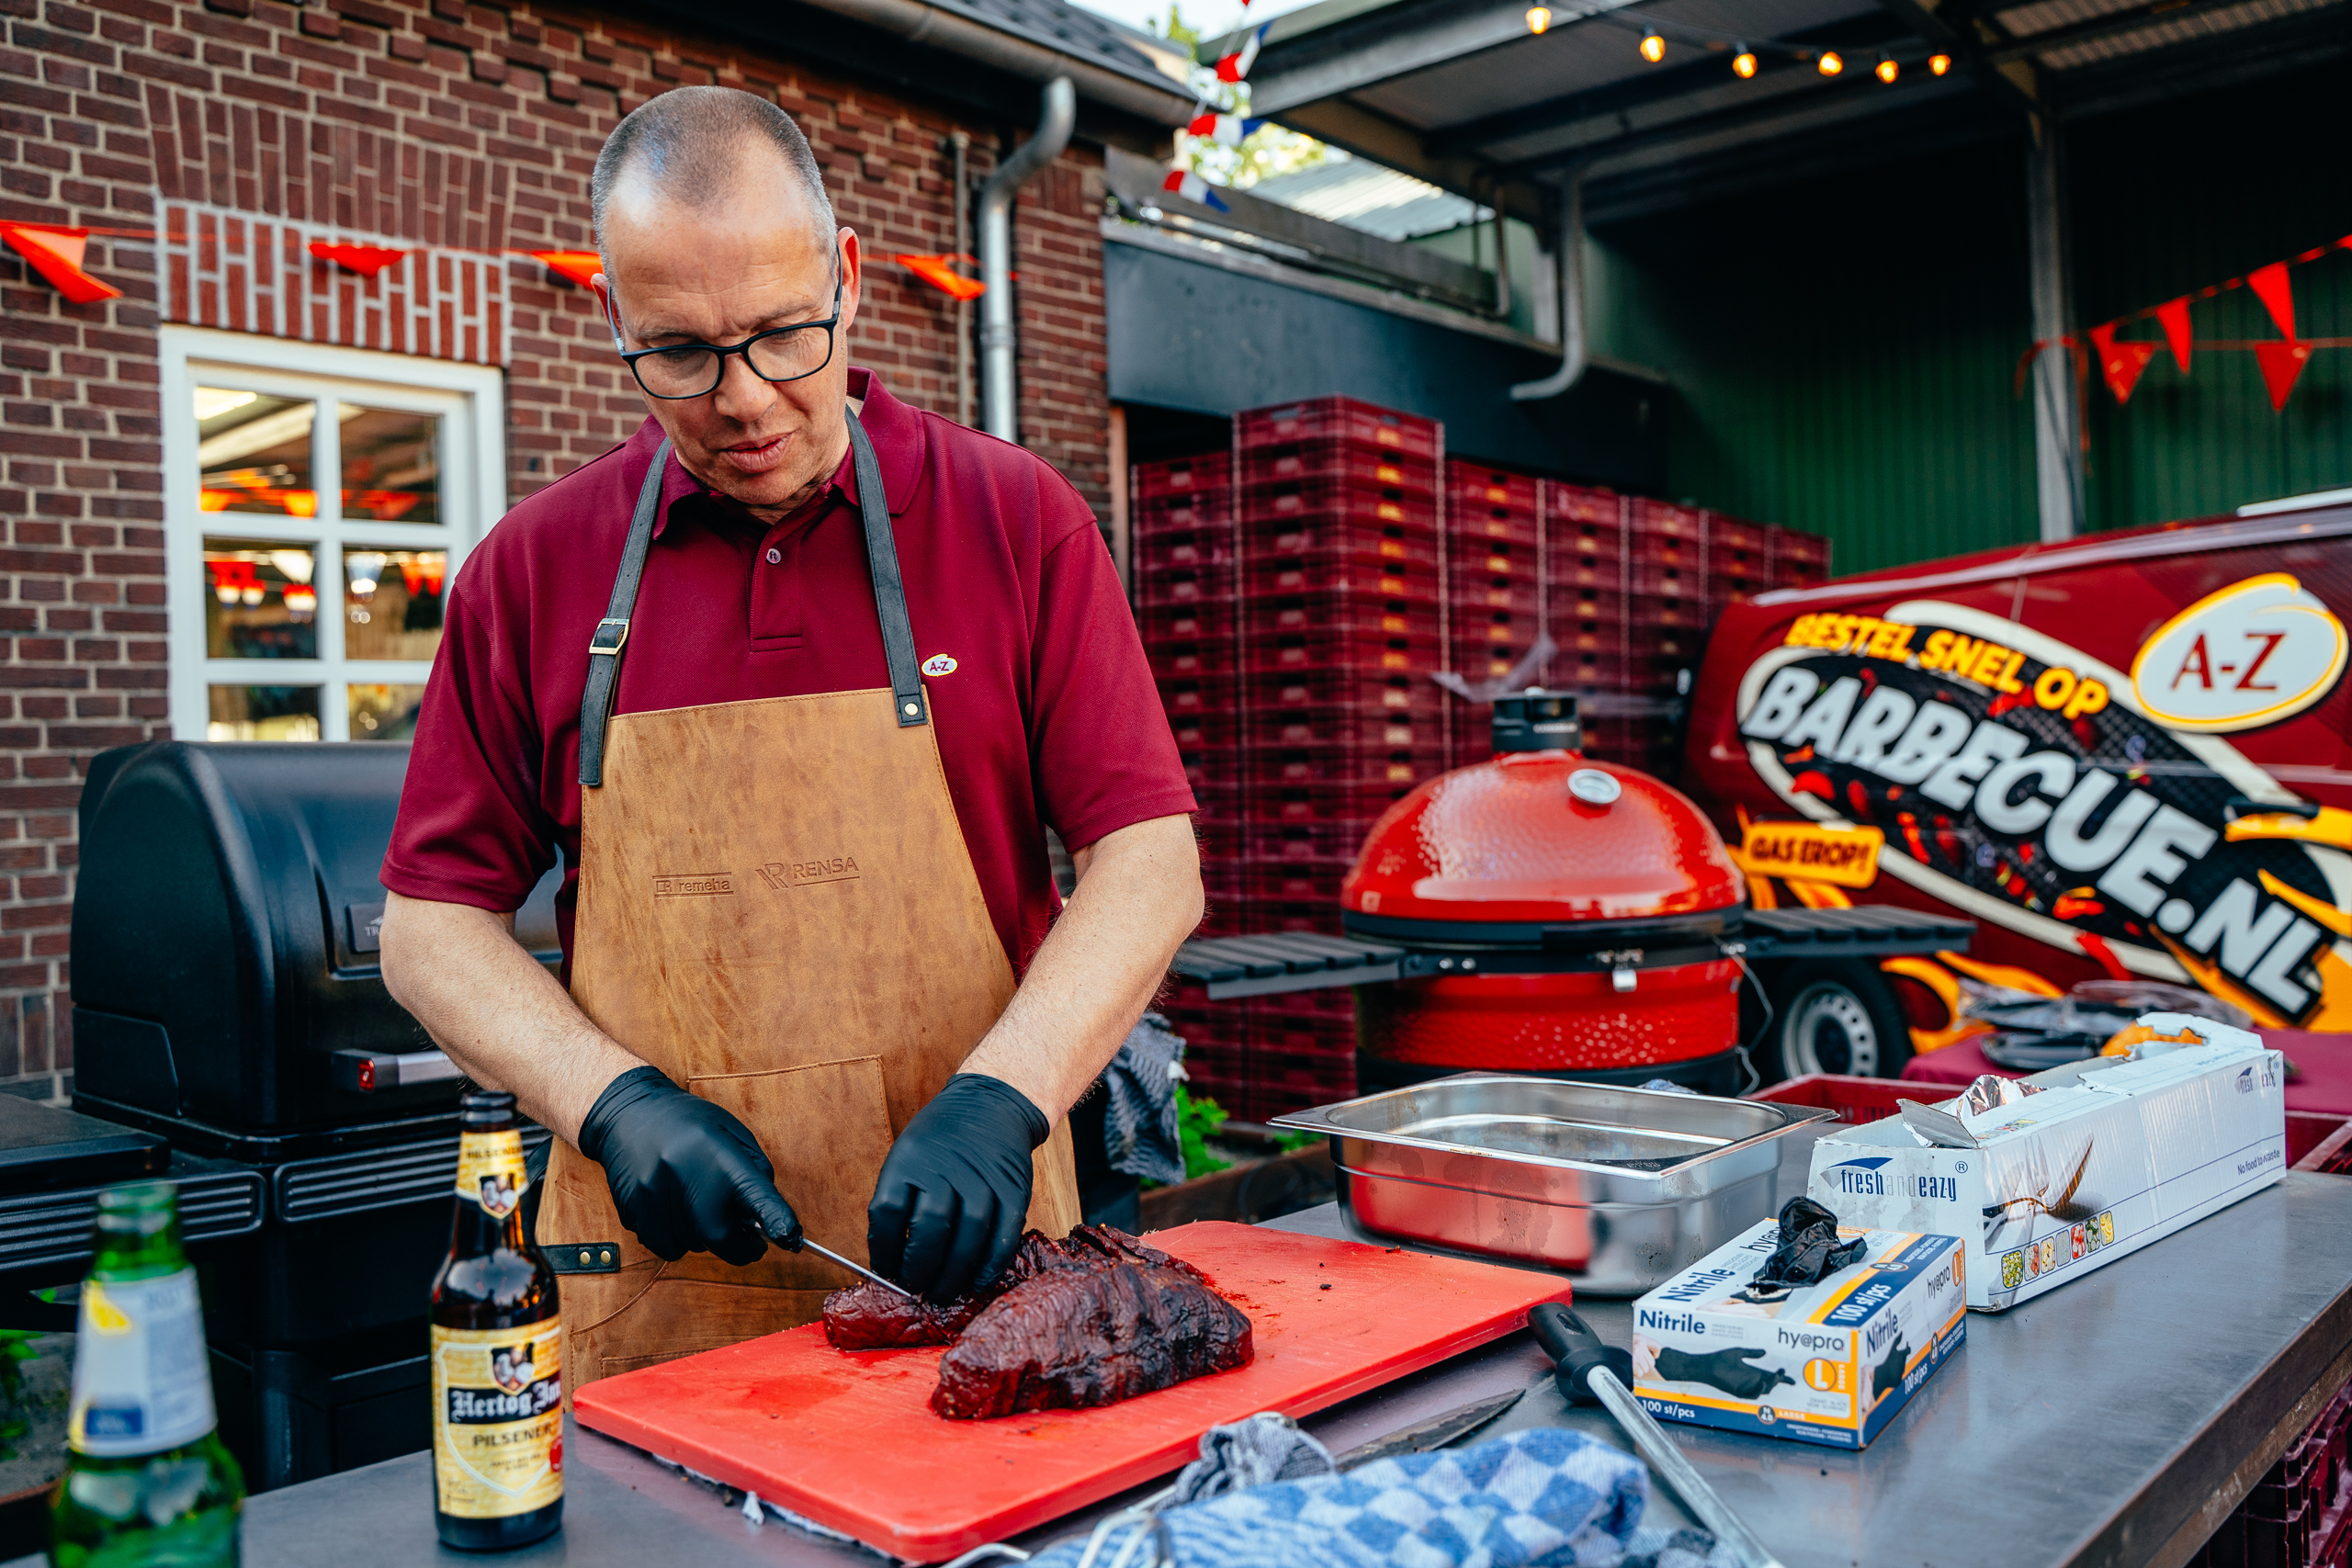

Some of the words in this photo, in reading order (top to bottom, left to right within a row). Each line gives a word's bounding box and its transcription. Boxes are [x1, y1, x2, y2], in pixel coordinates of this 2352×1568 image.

[930, 661, 950, 672] A-Z
[1784, 613, 1917, 663] BESTEL
[1918, 628, 2027, 694] SNEL
[2033, 666, 2110, 721] OP
[2170, 629, 2288, 694] A-Z
[1740, 666, 2323, 1014] BARBECUE.NL
[1749, 837, 1795, 862] GAS
[793, 856, 860, 880] RENSA
[679, 878, 731, 893] remeha
[2237, 1164, 2245, 1176] No
[2245, 1156, 2257, 1172] food
[2257, 1156, 2263, 1167] to
[1658, 1268, 1736, 1303] Nitrile
[1830, 1303, 1869, 1321] 100
[1854, 1283, 1893, 1306] st/pcs
[1639, 1309, 1706, 1335] Nitrile
[1866, 1307, 1899, 1359] Nitrile
[1778, 1327, 1845, 1351] hy@pro
[1814, 1359, 1828, 1389] L
[1904, 1376, 1914, 1395] 100
[1914, 1363, 1928, 1386] st/pcs
[450, 1390, 533, 1422] Hertog
[1642, 1399, 1662, 1413] 100
[1663, 1404, 1696, 1418] st/pcs
[473, 1421, 552, 1447] PILSENER
